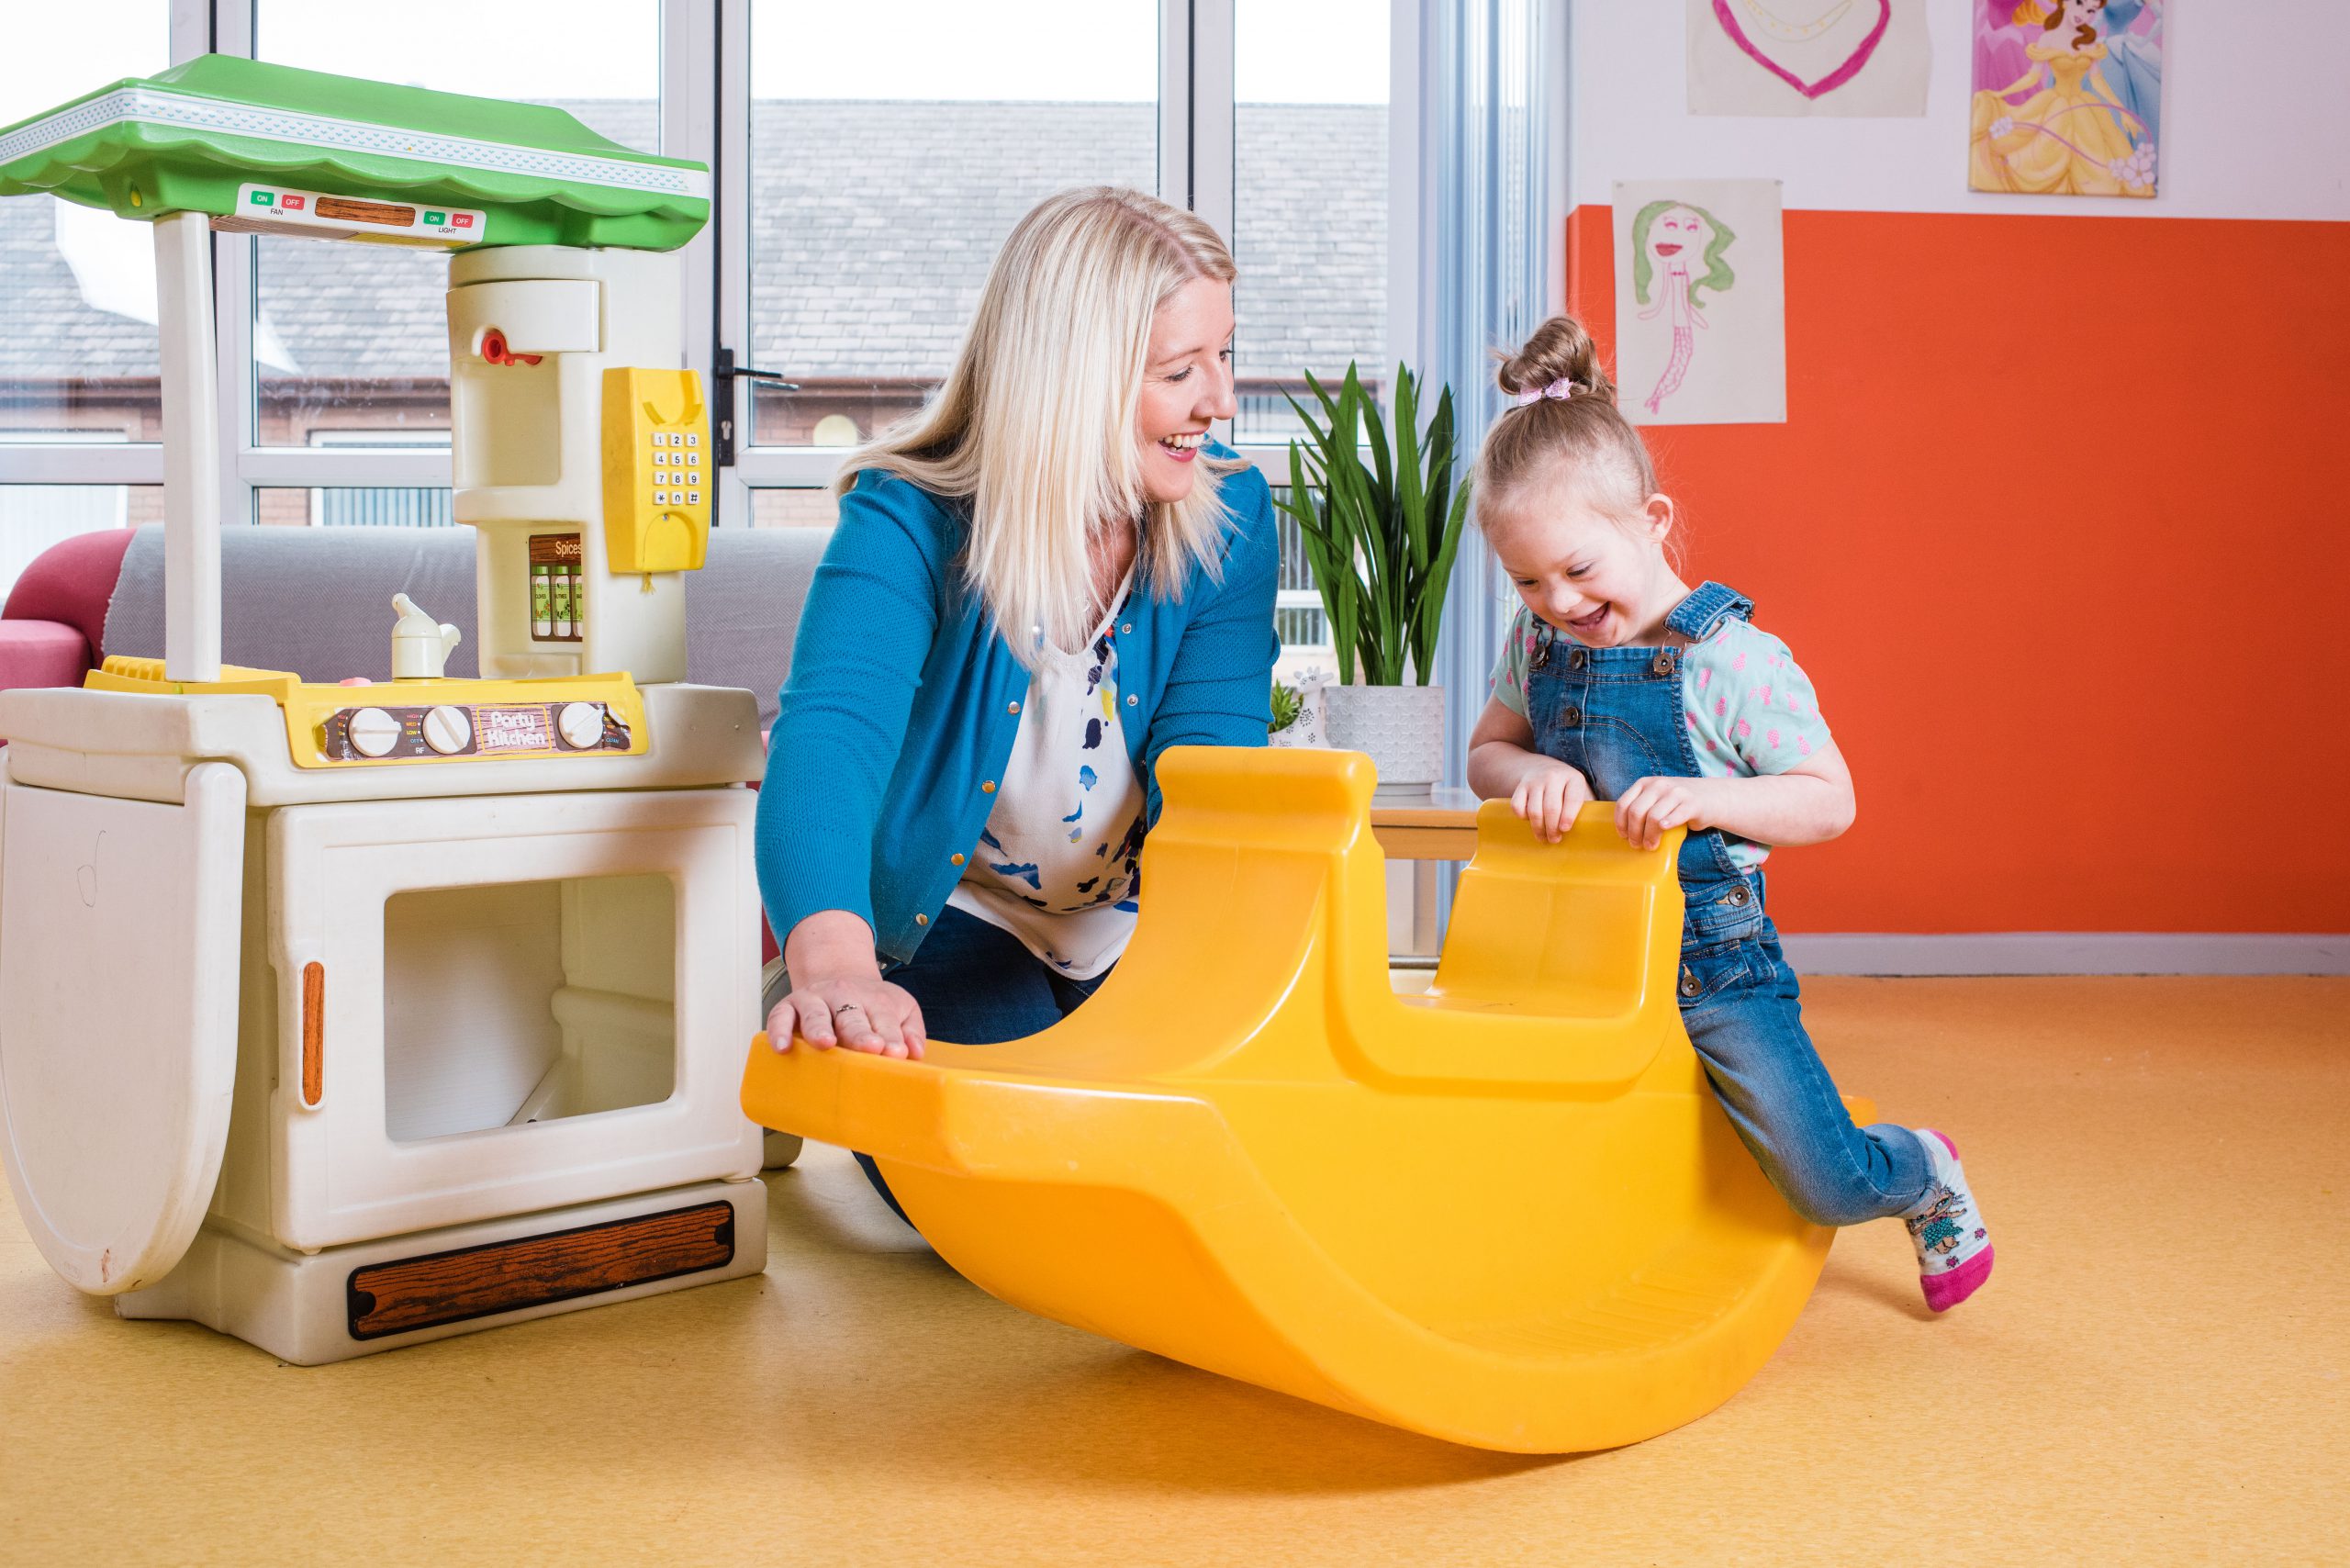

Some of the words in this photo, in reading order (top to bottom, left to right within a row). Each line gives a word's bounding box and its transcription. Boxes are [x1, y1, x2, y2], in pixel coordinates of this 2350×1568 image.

[270, 207, 284, 216] FAN
[675, 436, 680, 444] 2
[690, 436, 696, 444] 3
[675, 455, 680, 464] 5
[690, 455, 697, 464] 6
[675, 475, 681, 483] 8
[691, 475, 697, 483] 9
[675, 494, 680, 502] 0
[555, 541, 581, 557] Spices
[490, 711, 536, 731] Party
[487, 729, 546, 746] Kitchen
[415, 746, 425, 755] RF
